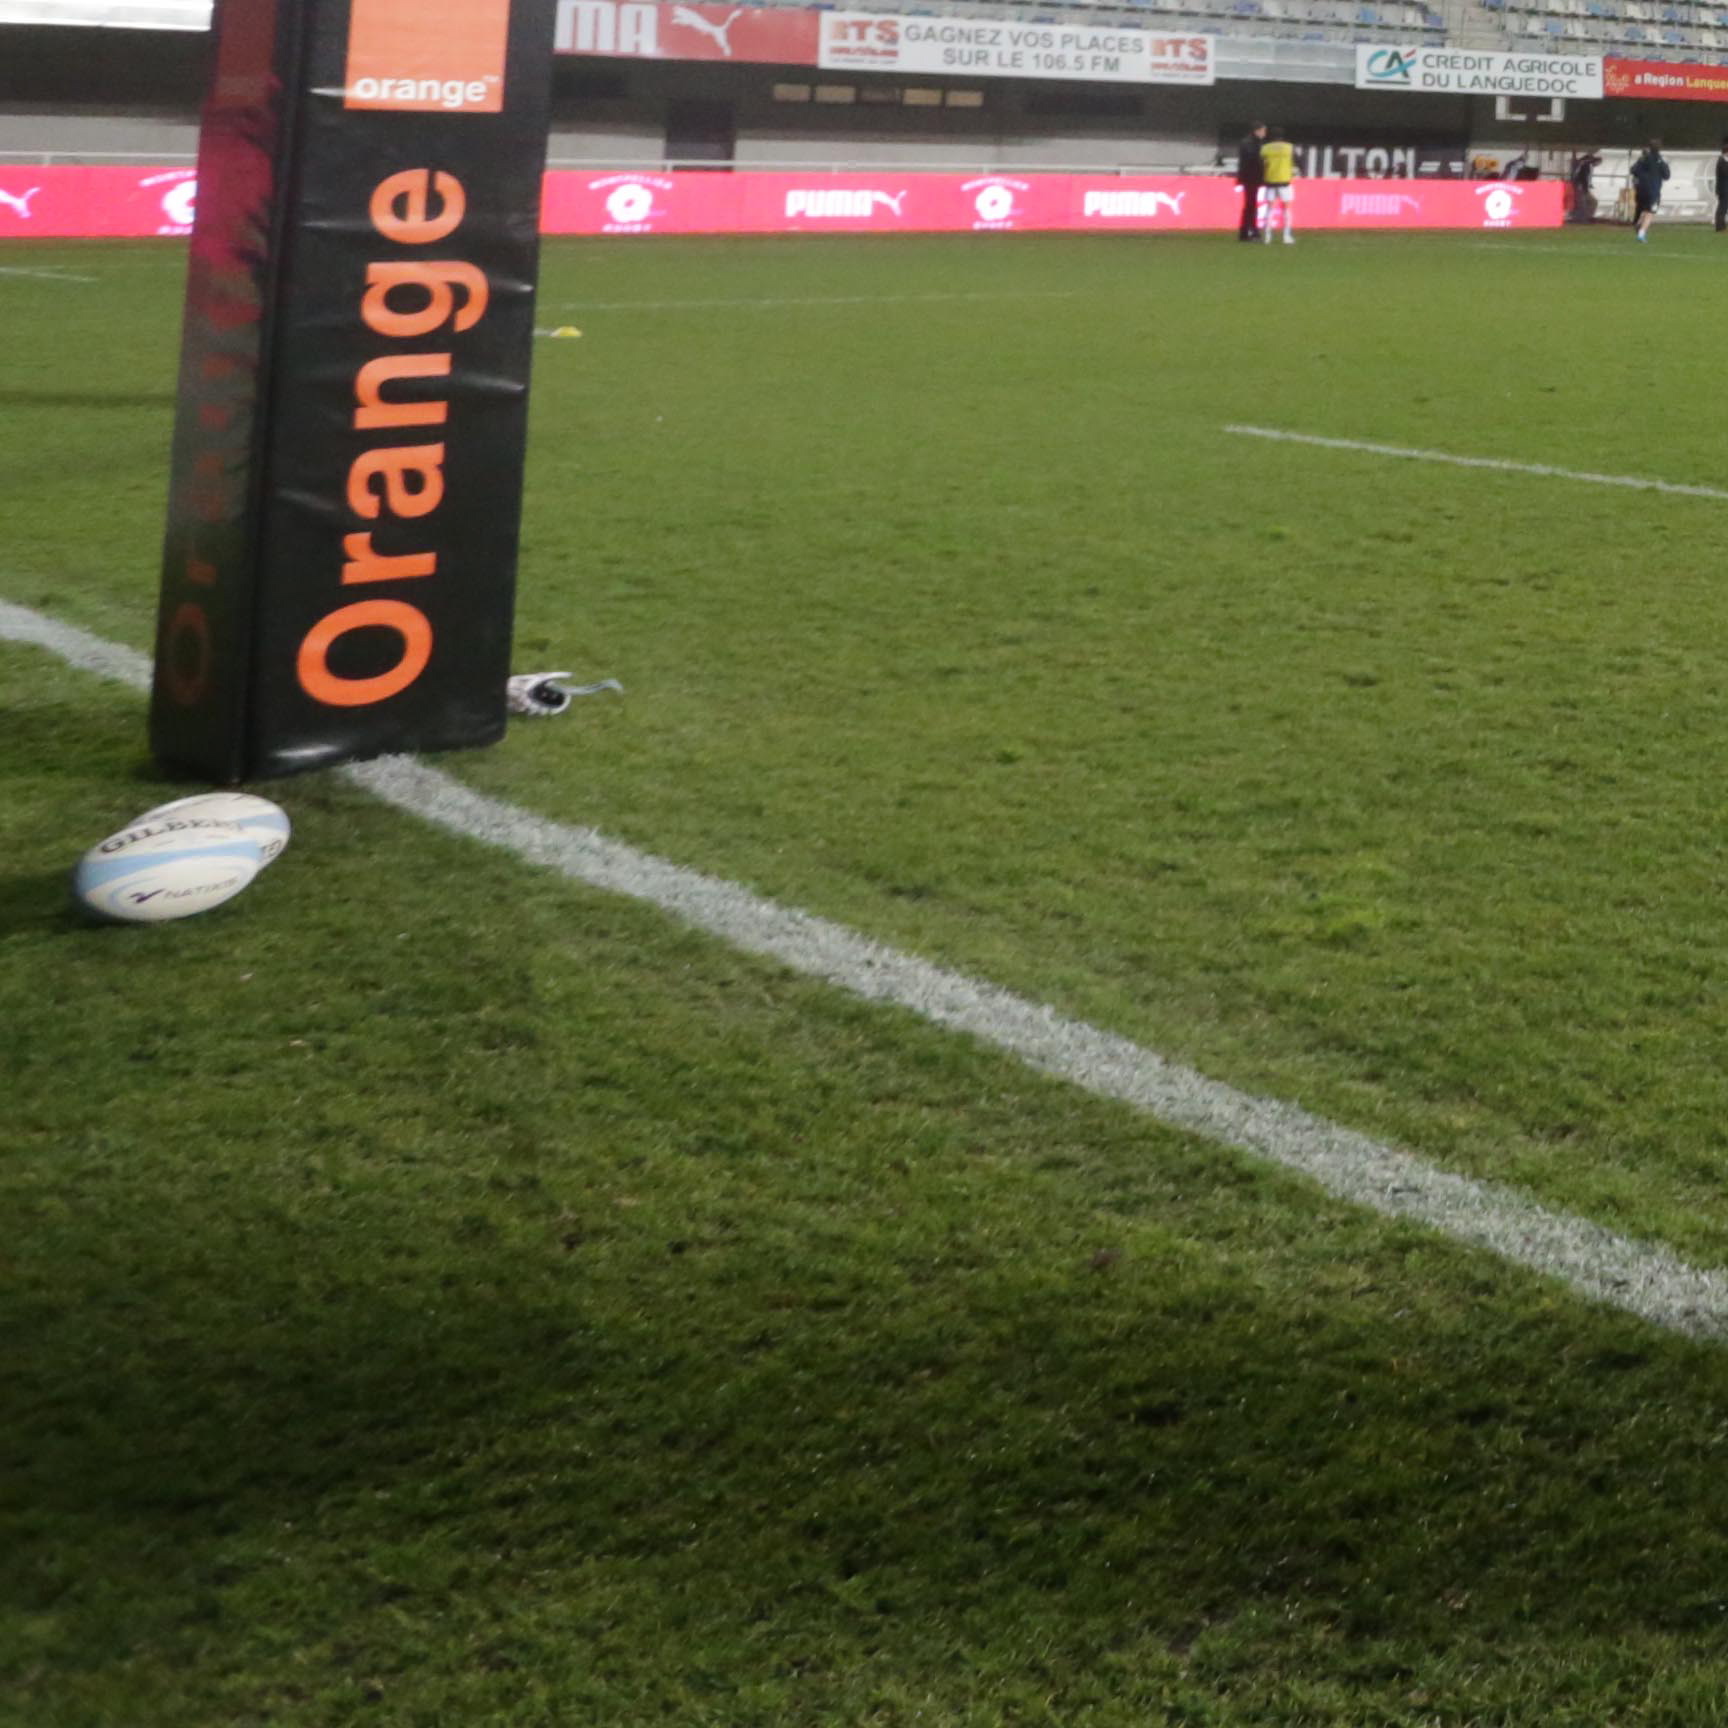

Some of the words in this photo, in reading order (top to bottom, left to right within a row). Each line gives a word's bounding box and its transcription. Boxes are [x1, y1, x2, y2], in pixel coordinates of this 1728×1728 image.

[904, 24, 1002, 47] GAGNEZ
[1010, 29, 1053, 49] VOS
[1061, 33, 1143, 54] PLACES
[943, 46, 990, 66] SUR
[997, 52, 1023, 68] LE
[1033, 52, 1085, 71] 106.5
[1091, 55, 1120, 72] FM
[1503, 58, 1596, 77] AGRICOLE
[355, 77, 486, 109] orange
[1422, 73, 1450, 88] DU
[1458, 75, 1577, 93] LANGUEDOC
[1293, 145, 1416, 180] ILTON
[785, 190, 874, 217] PUMA
[297, 169, 489, 706] Orange
